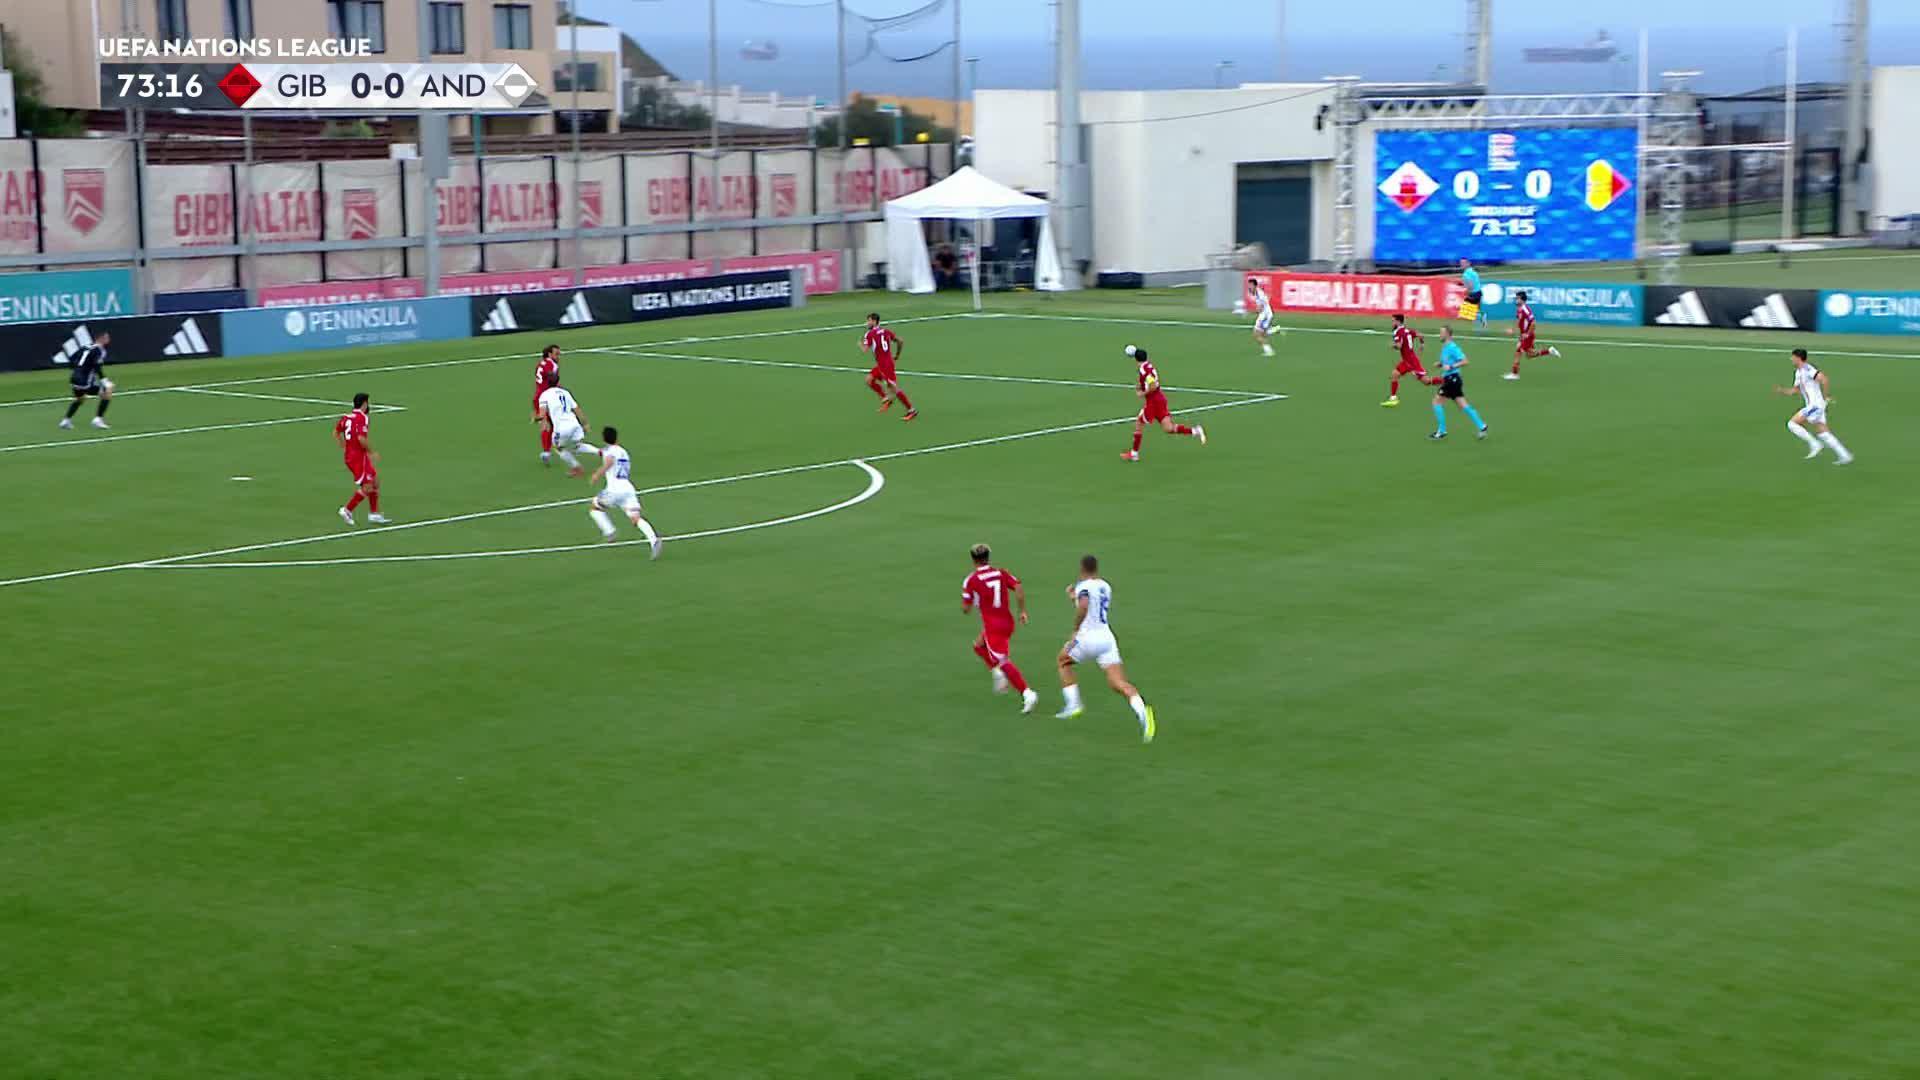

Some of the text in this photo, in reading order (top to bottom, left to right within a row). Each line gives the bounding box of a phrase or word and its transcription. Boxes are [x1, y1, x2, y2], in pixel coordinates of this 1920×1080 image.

[1453, 170, 1479, 199] 0
[1525, 169, 1551, 199] 0
[1281, 280, 1399, 310] GIBRALTAR
[1403, 283, 1434, 311] FA
[309, 305, 418, 333] PENINSULA
[535, 366, 544, 385] 5
[985, 579, 1002, 609] 7
